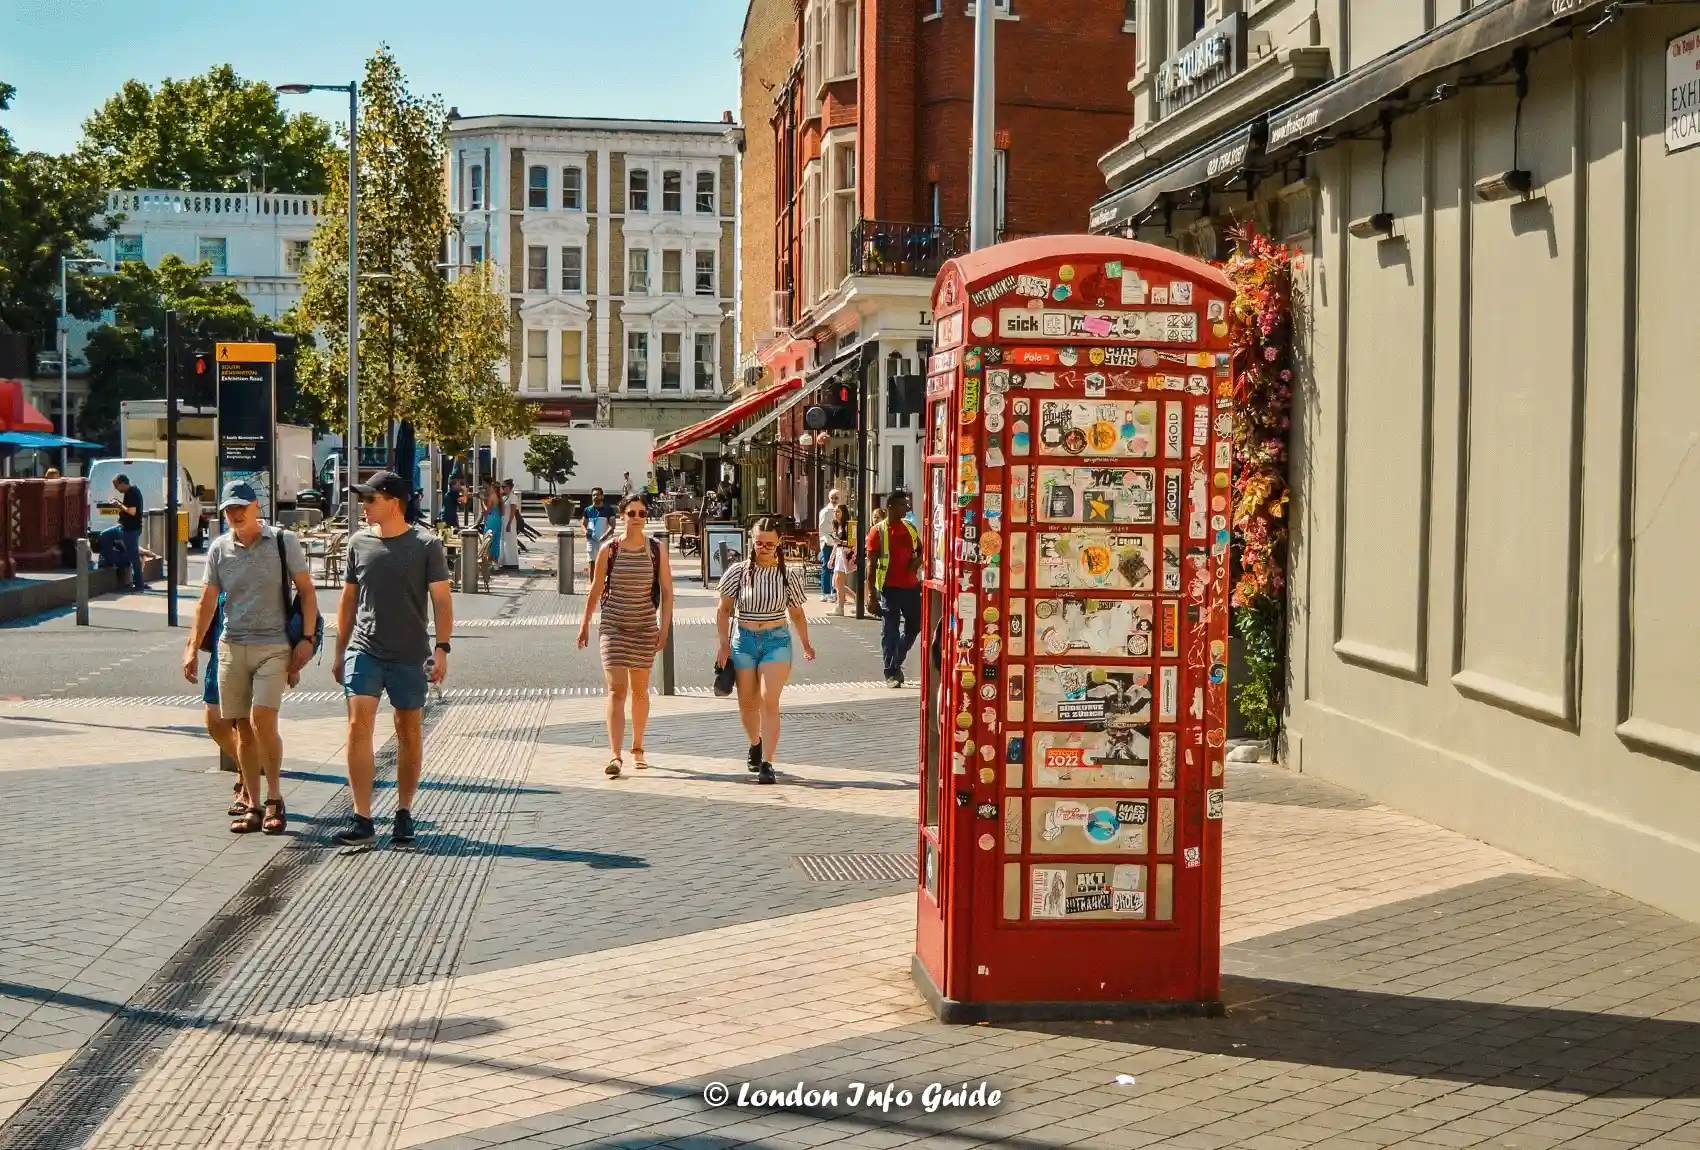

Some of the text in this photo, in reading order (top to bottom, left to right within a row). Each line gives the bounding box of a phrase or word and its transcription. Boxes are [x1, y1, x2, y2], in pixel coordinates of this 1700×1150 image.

[1177, 33, 1225, 87] SQUARE
[1672, 78, 1700, 111] EXHI
[1008, 316, 1039, 331] sick
[1047, 755, 1079, 767] 2022
[1119, 803, 1146, 815] MAES
